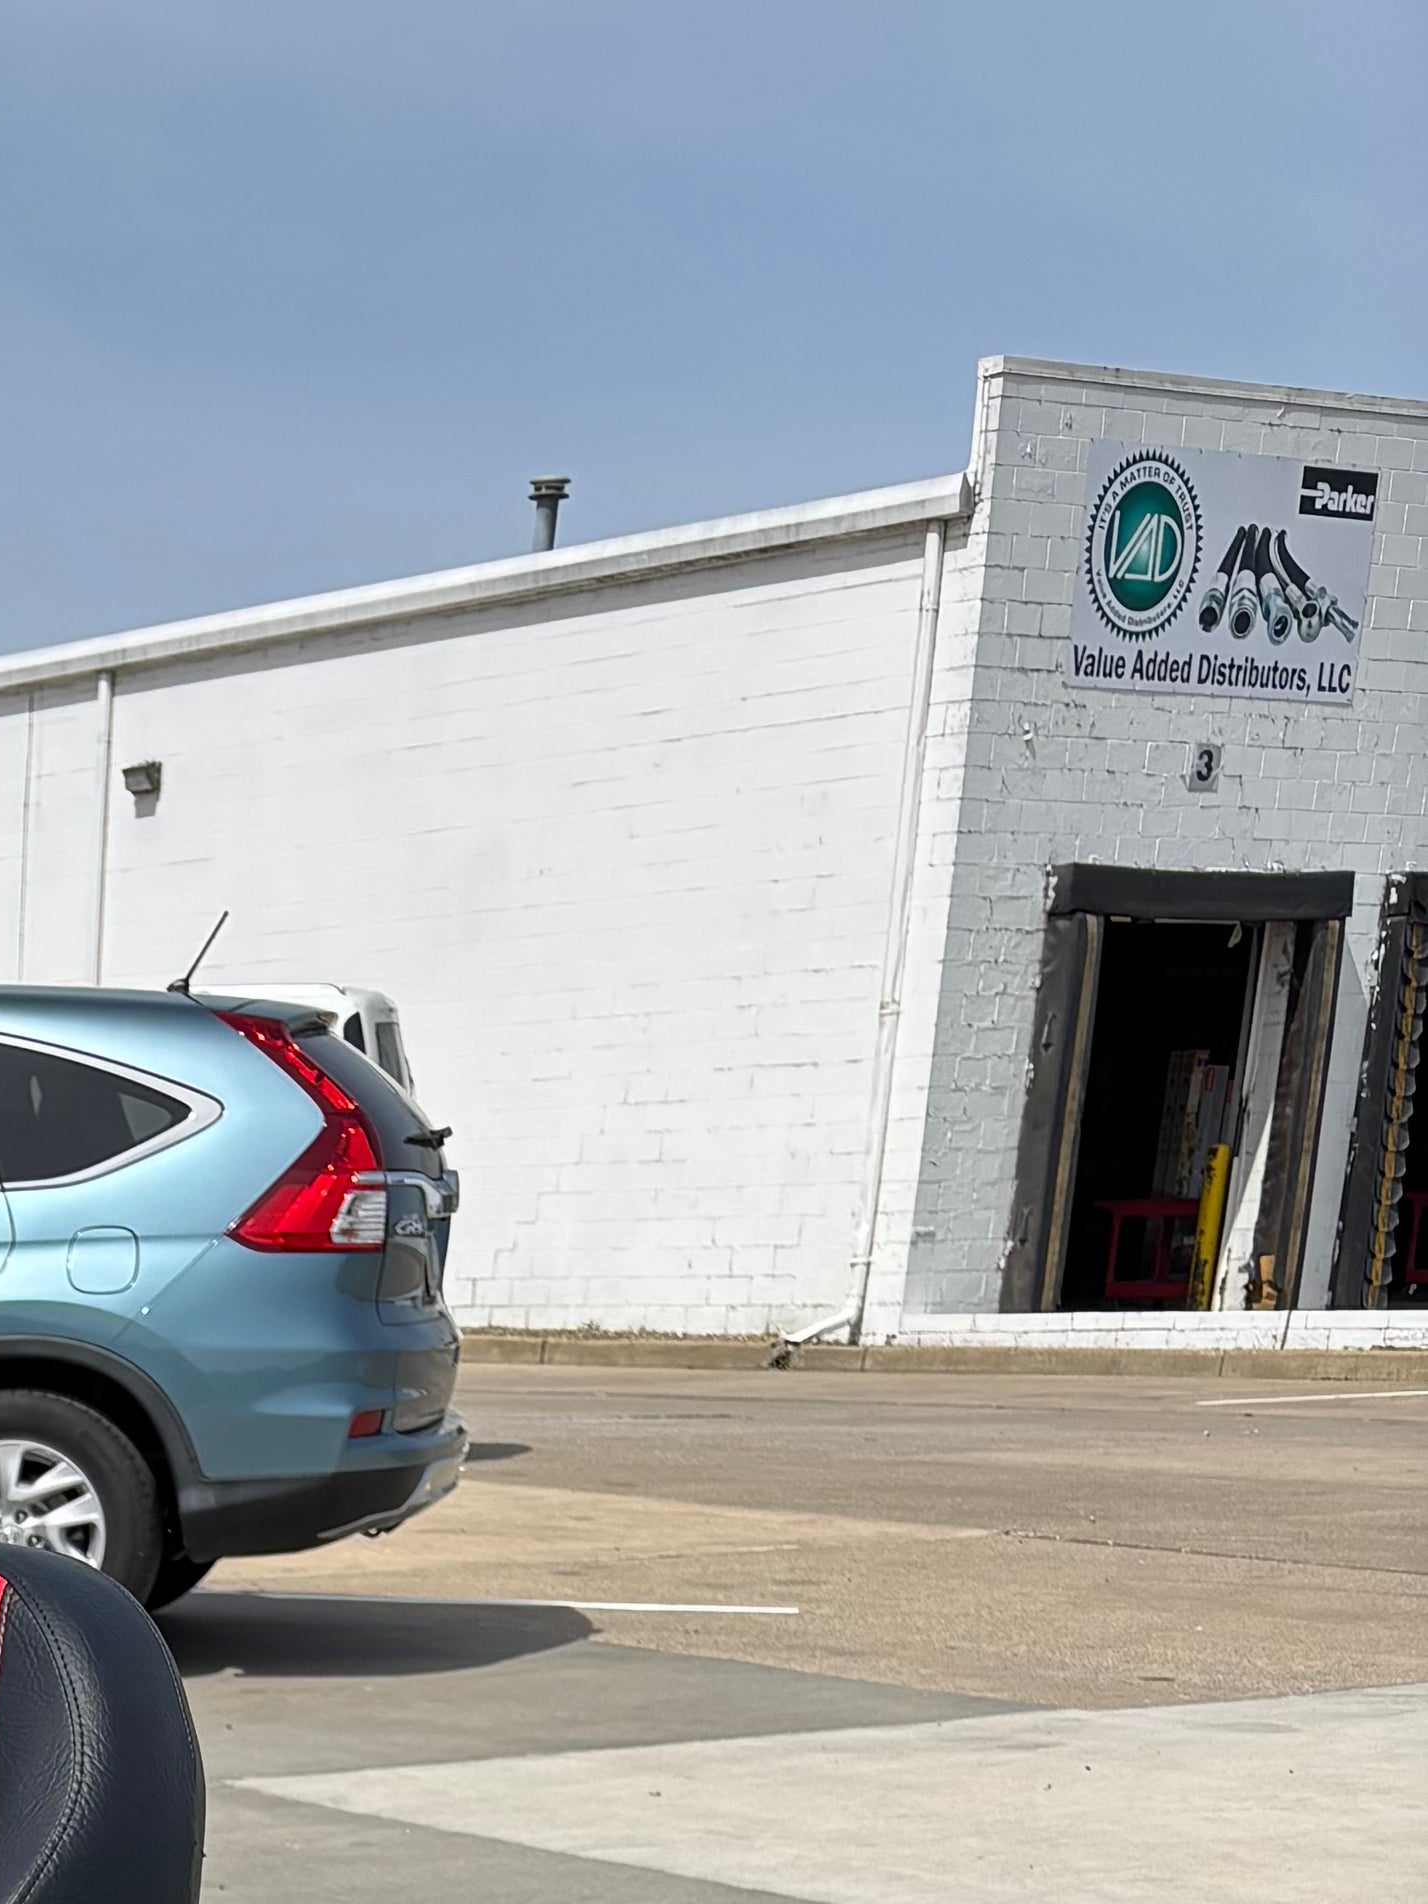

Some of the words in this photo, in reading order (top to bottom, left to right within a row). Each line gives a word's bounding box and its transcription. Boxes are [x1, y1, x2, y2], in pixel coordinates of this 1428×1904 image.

[1120, 465, 1161, 490] MATTER
[1163, 470, 1178, 486] OF
[1175, 484, 1195, 532] TRUST
[1306, 481, 1376, 516] Parker
[1073, 644, 1126, 680] Value
[1130, 648, 1191, 684] Added
[1197, 653, 1312, 697] Distributors,
[1317, 662, 1352, 694] LLC
[1196, 749, 1214, 782] 3
